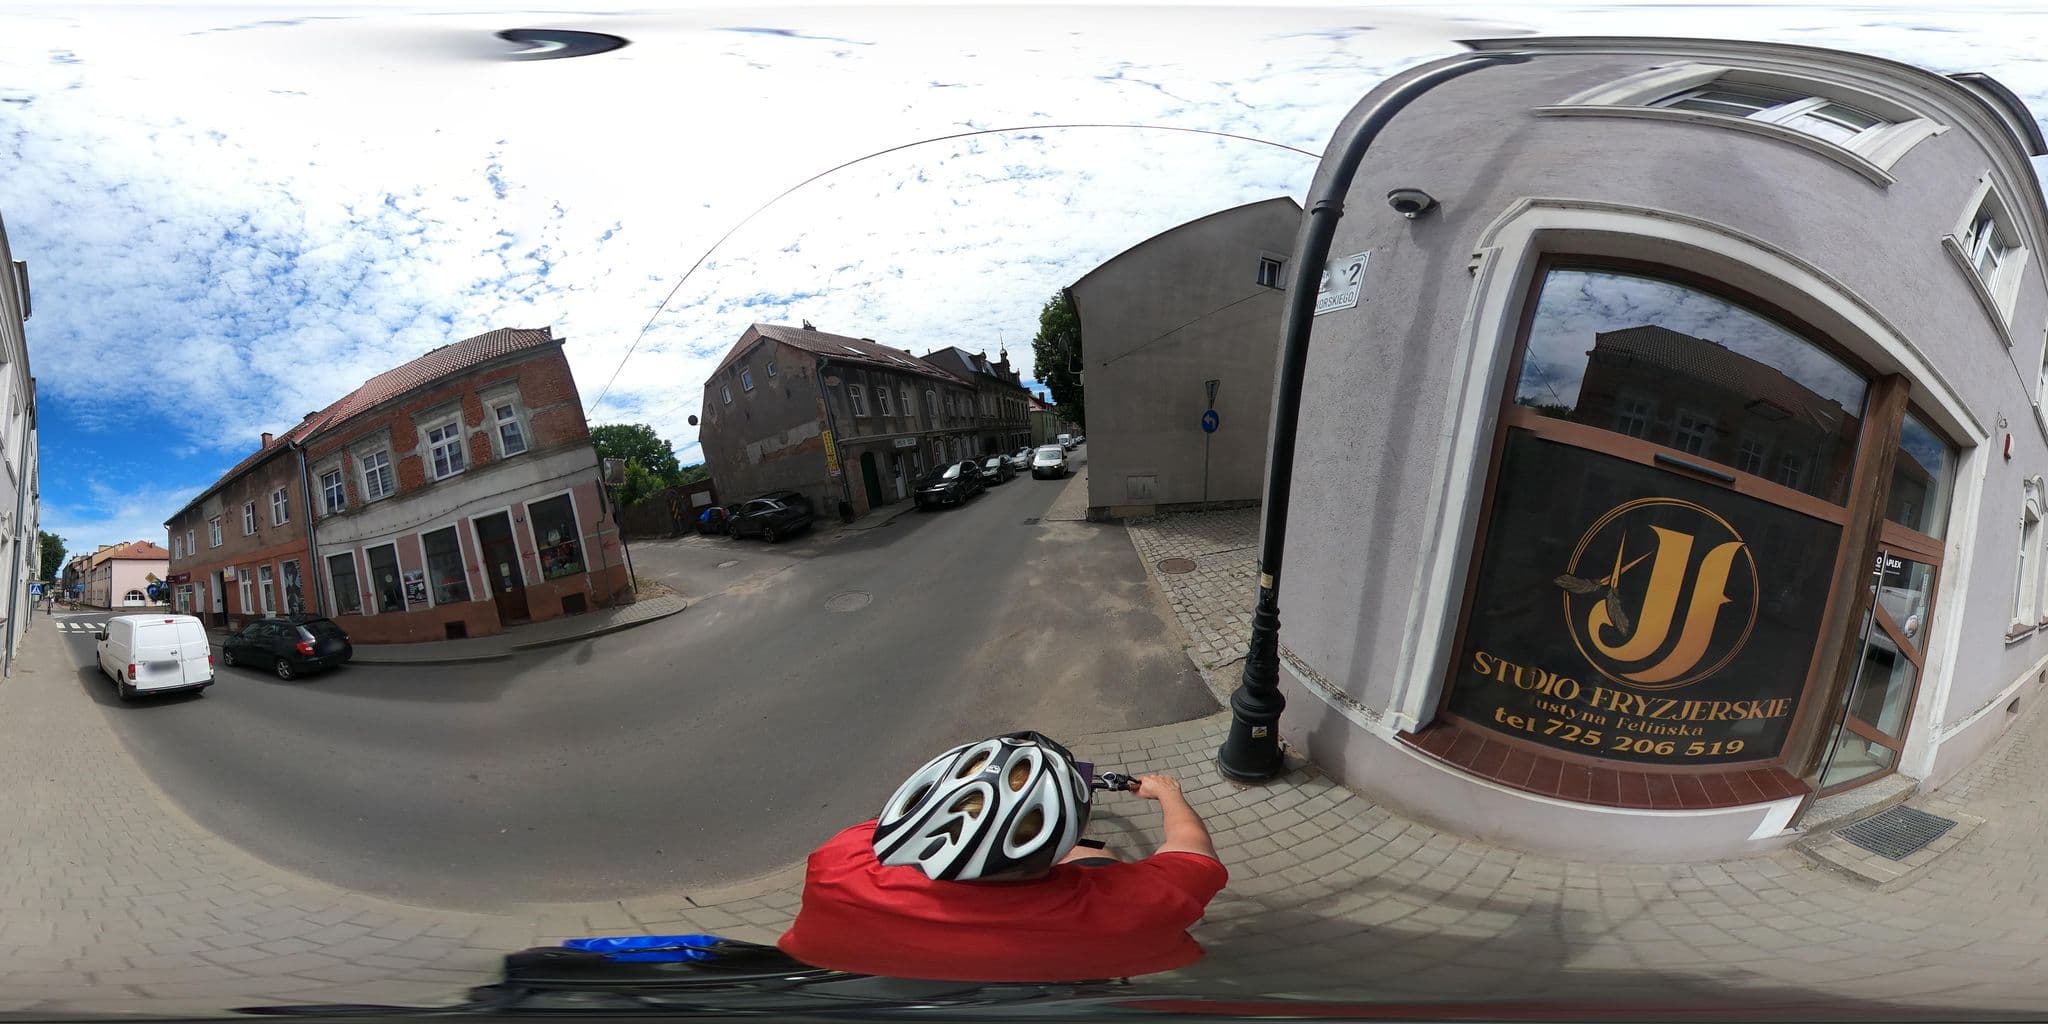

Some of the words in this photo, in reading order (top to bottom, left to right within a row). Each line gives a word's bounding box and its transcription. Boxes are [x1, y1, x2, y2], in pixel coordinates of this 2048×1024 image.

[1473, 650, 1581, 700] STUDIO
[1590, 686, 1792, 721] FRYZJERSKIE
[1494, 707, 1537, 732] tel
[1544, 718, 1603, 745] 725
[1610, 736, 1676, 755] 206
[1684, 739, 1745, 756] 519
[1533, 699, 1606, 725] ustyna
[1616, 717, 1704, 736] Felińska
